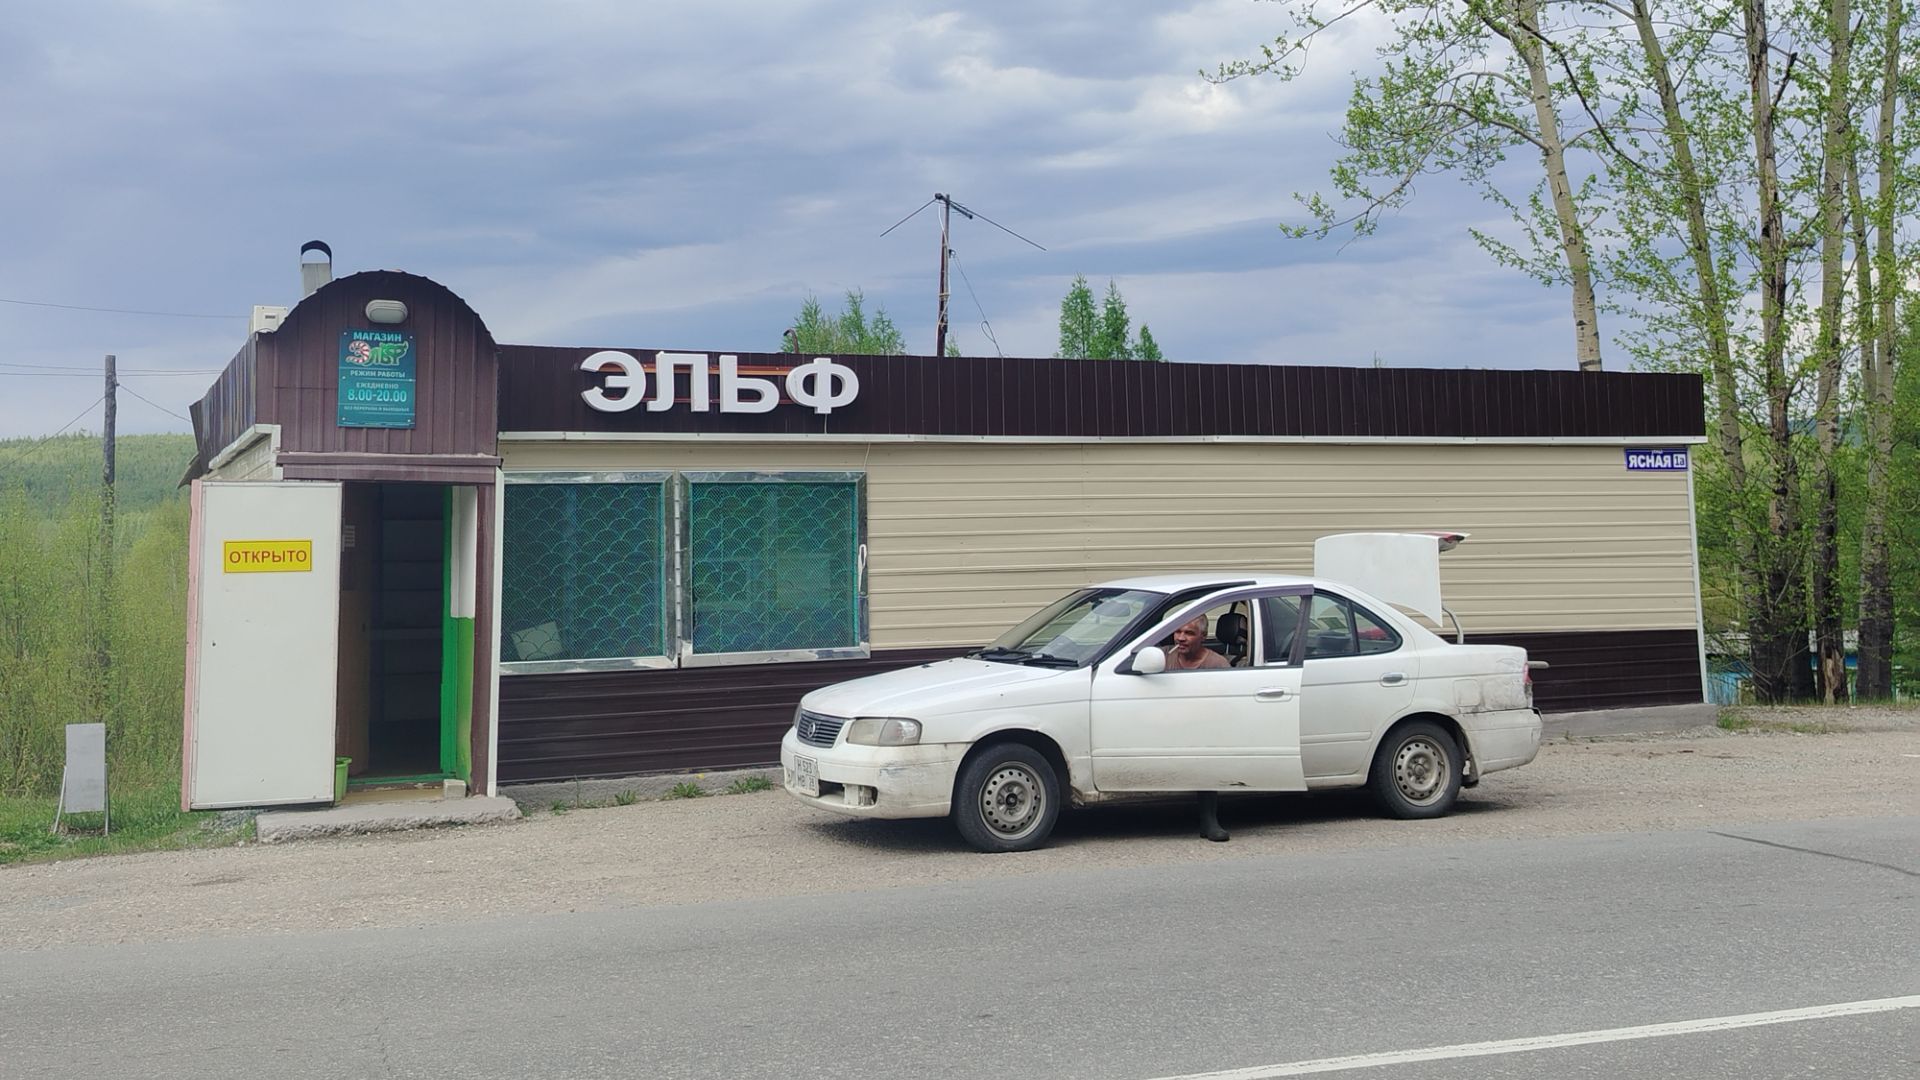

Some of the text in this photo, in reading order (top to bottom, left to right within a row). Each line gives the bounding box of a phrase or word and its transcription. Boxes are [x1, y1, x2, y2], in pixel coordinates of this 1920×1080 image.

[353, 332, 402, 342] МАГАЗИН
[350, 369, 376, 377] РЕЖИМ
[580, 350, 859, 415] ЭЛЬФ
[347, 389, 407, 402] 8.00-20.00
[1629, 454, 1672, 468] ЯСНАЯ
[229, 550, 307, 564] ОТКРЫТО
